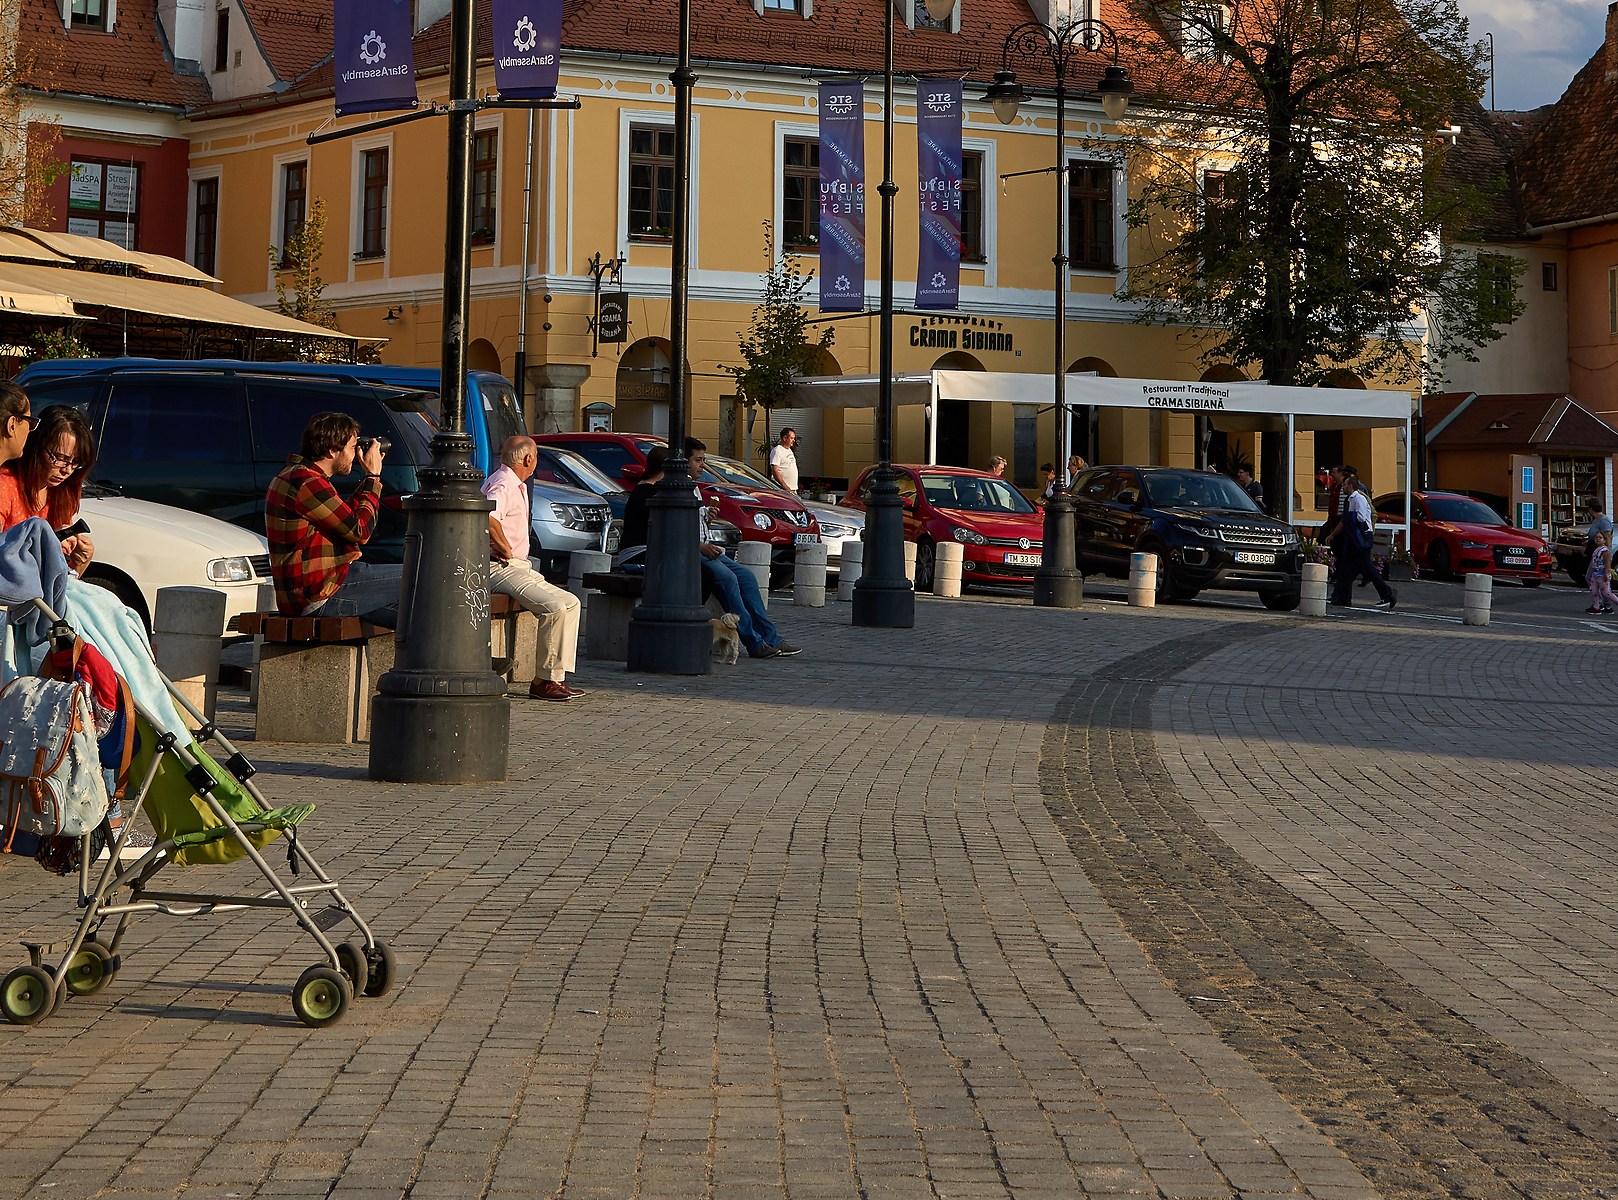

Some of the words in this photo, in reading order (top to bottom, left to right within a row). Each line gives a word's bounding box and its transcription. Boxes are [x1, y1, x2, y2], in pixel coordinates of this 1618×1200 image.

[602, 314, 621, 323] CRAMA
[921, 316, 1003, 330] RESTAURANT
[1143, 385, 1185, 394] Restaurant
[1148, 397, 1183, 408] CRAMA
[1185, 398, 1225, 409] SIBIANĂ
